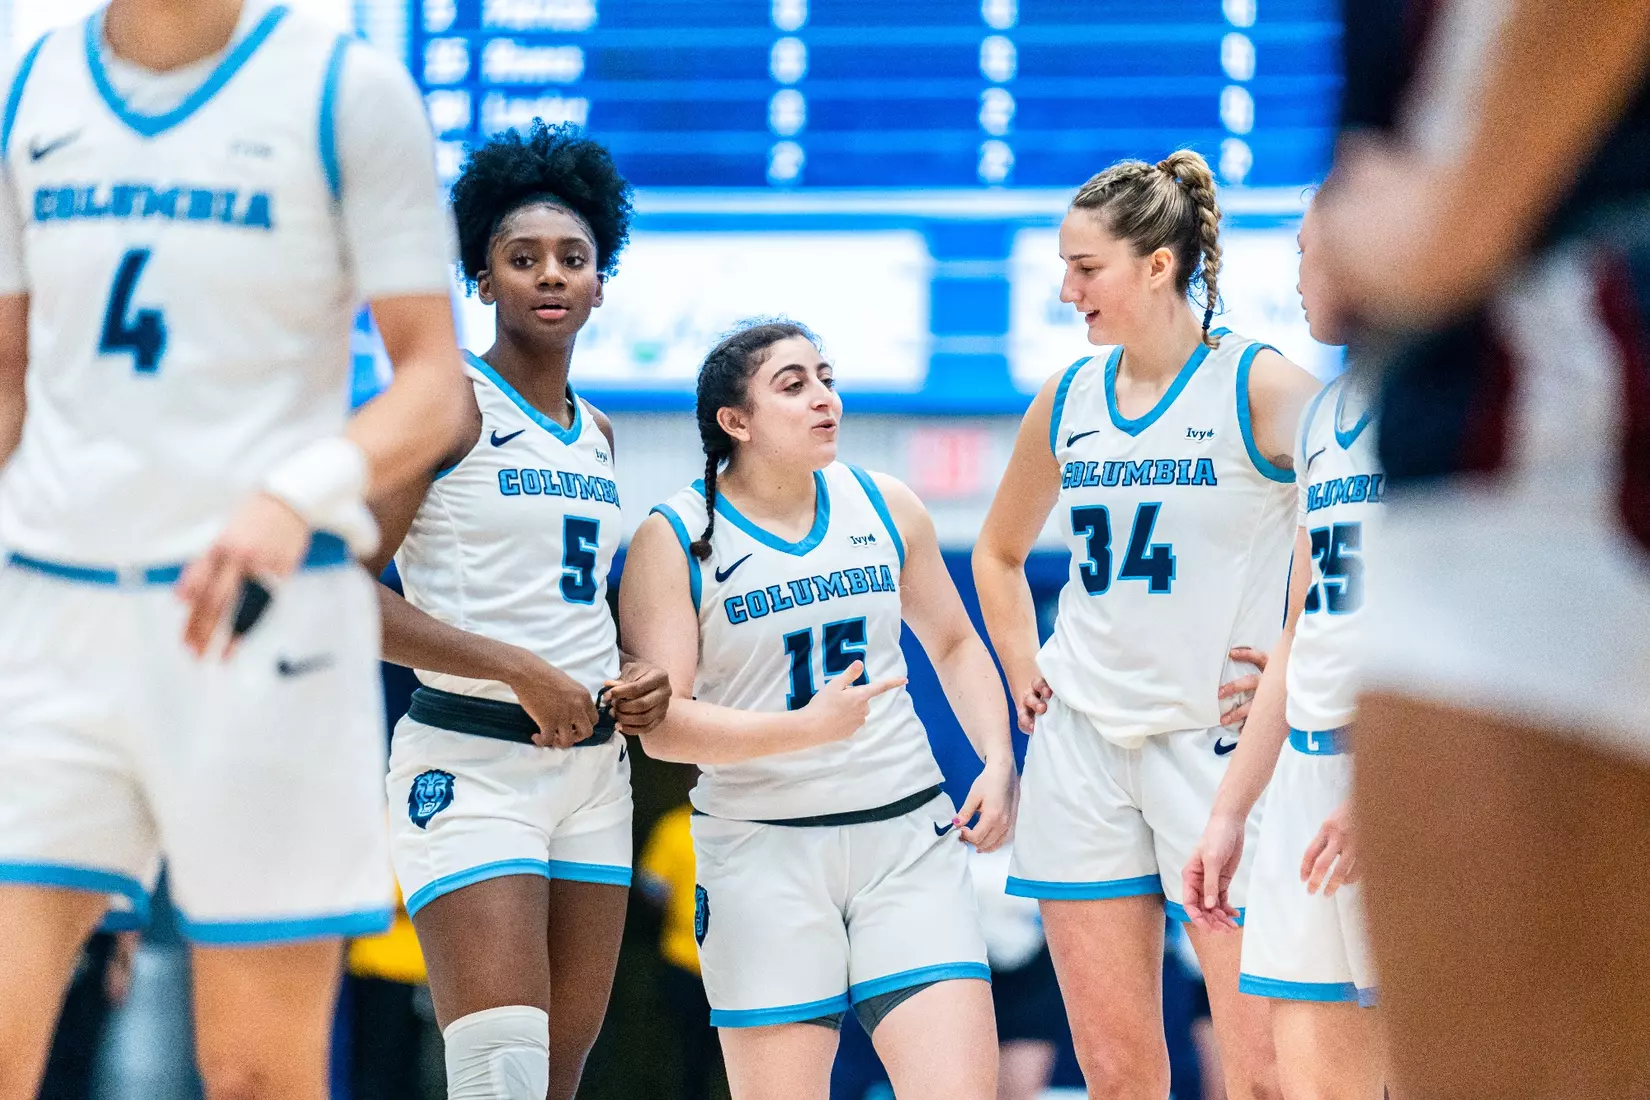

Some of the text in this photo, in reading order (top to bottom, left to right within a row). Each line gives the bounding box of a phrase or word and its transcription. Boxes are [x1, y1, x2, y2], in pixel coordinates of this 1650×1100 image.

[34, 183, 274, 230] COLUMBIA
[97, 248, 168, 374] 4
[1186, 427, 1206, 441] Ivy
[1061, 458, 1217, 489] COLUMBIA
[558, 514, 600, 605] 5
[850, 535, 868, 546] Ivy
[1070, 501, 1177, 596] 34
[723, 564, 896, 625] COLUMBIA
[782, 615, 870, 711] 15
